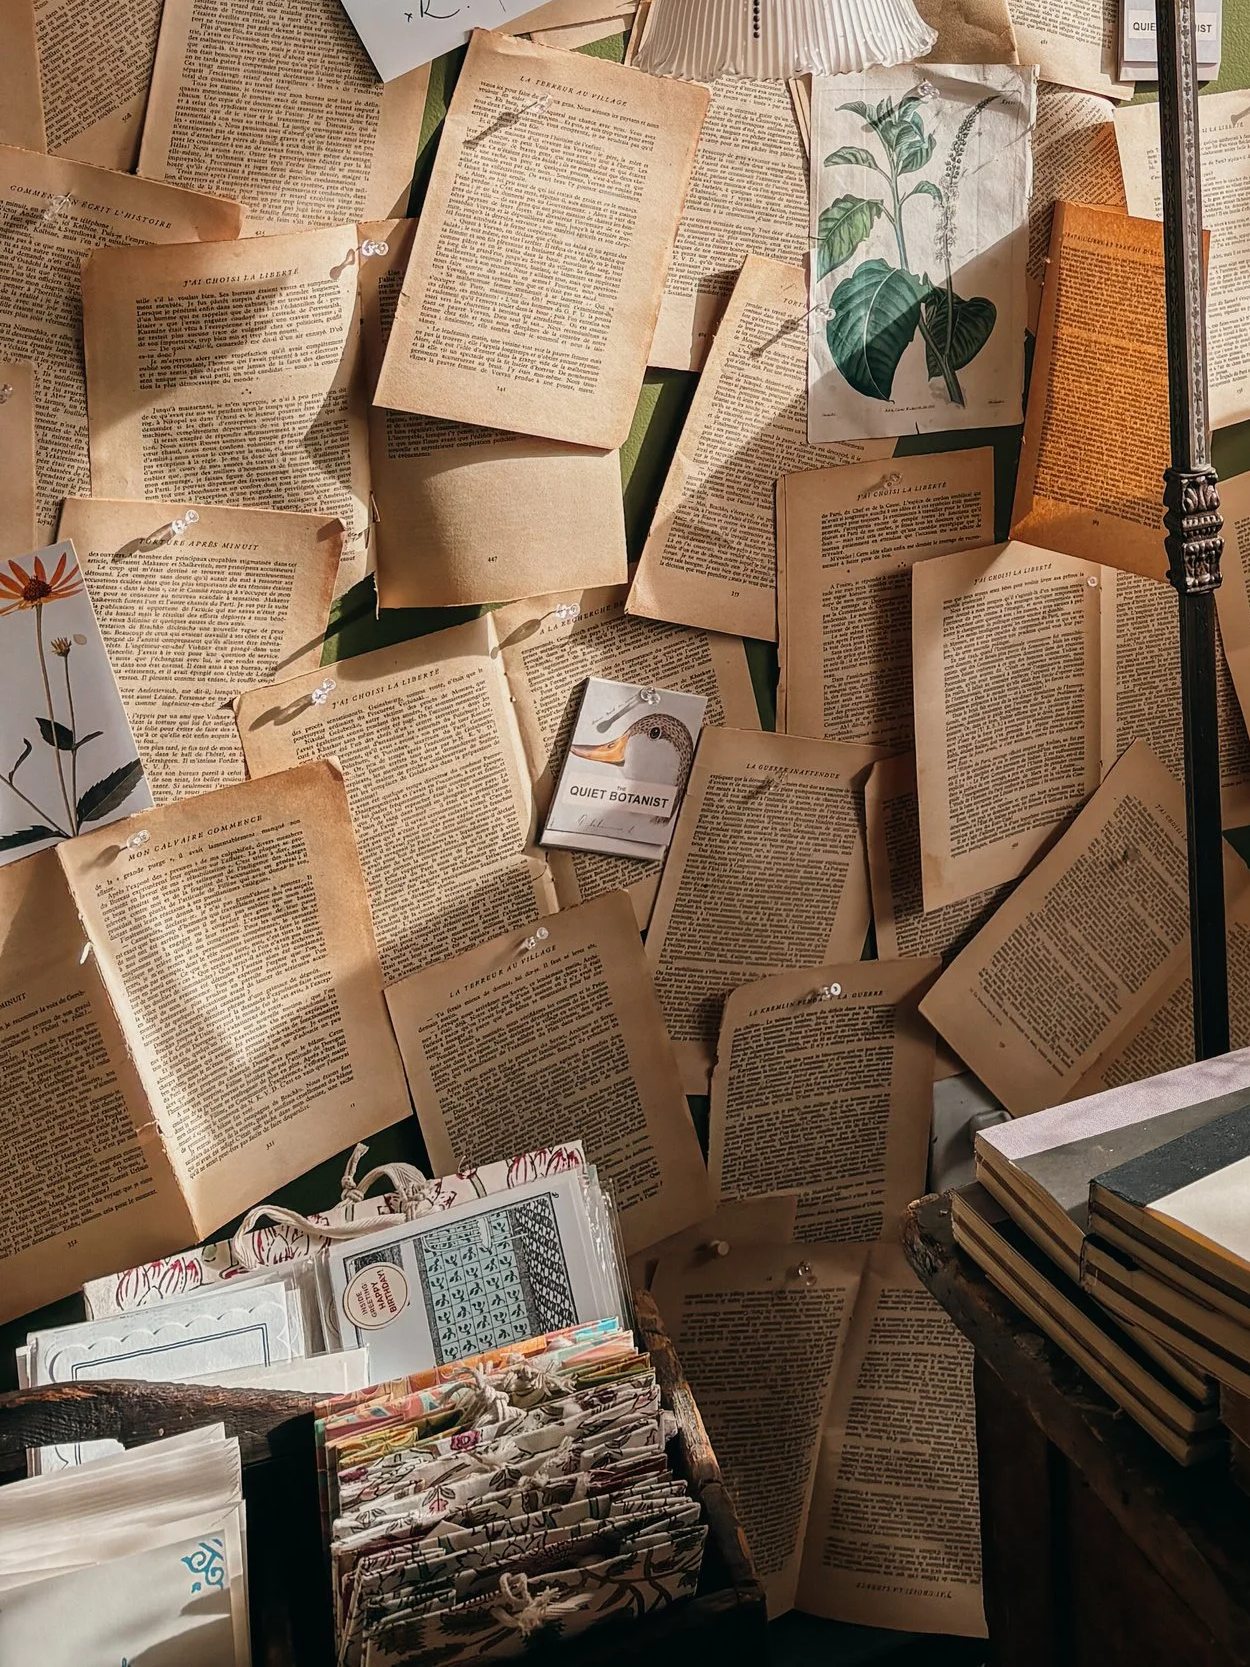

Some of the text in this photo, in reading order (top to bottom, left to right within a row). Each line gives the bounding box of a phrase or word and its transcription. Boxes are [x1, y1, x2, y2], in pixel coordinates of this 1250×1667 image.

[1132, 22, 1157, 31] QUIE
[520, 75, 627, 107] LA TERREUR AU VILLAGE
[183, 279, 201, 287] J'AI
[205, 274, 240, 285] CHOISI
[856, 492, 870, 500] J'AI
[873, 488, 899, 496] CHOISI
[139, 537, 184, 546] TORTURE
[221, 542, 258, 550] MINUIT
[331, 697, 349, 708] J'AI
[351, 686, 384, 701] CHOISI
[386, 682, 398, 690] LA
[569, 785, 669, 808] QUIET BOTANIST
[127, 814, 262, 860] MON CALVAIRE COMMENCE
[448, 944, 557, 998] LA TERREUR AU VILLAGE
[370, 1281, 386, 1310] HAPPY
[376, 1268, 398, 1313] BIRTHDAY!
[356, 1291, 368, 1316] INSIDE
